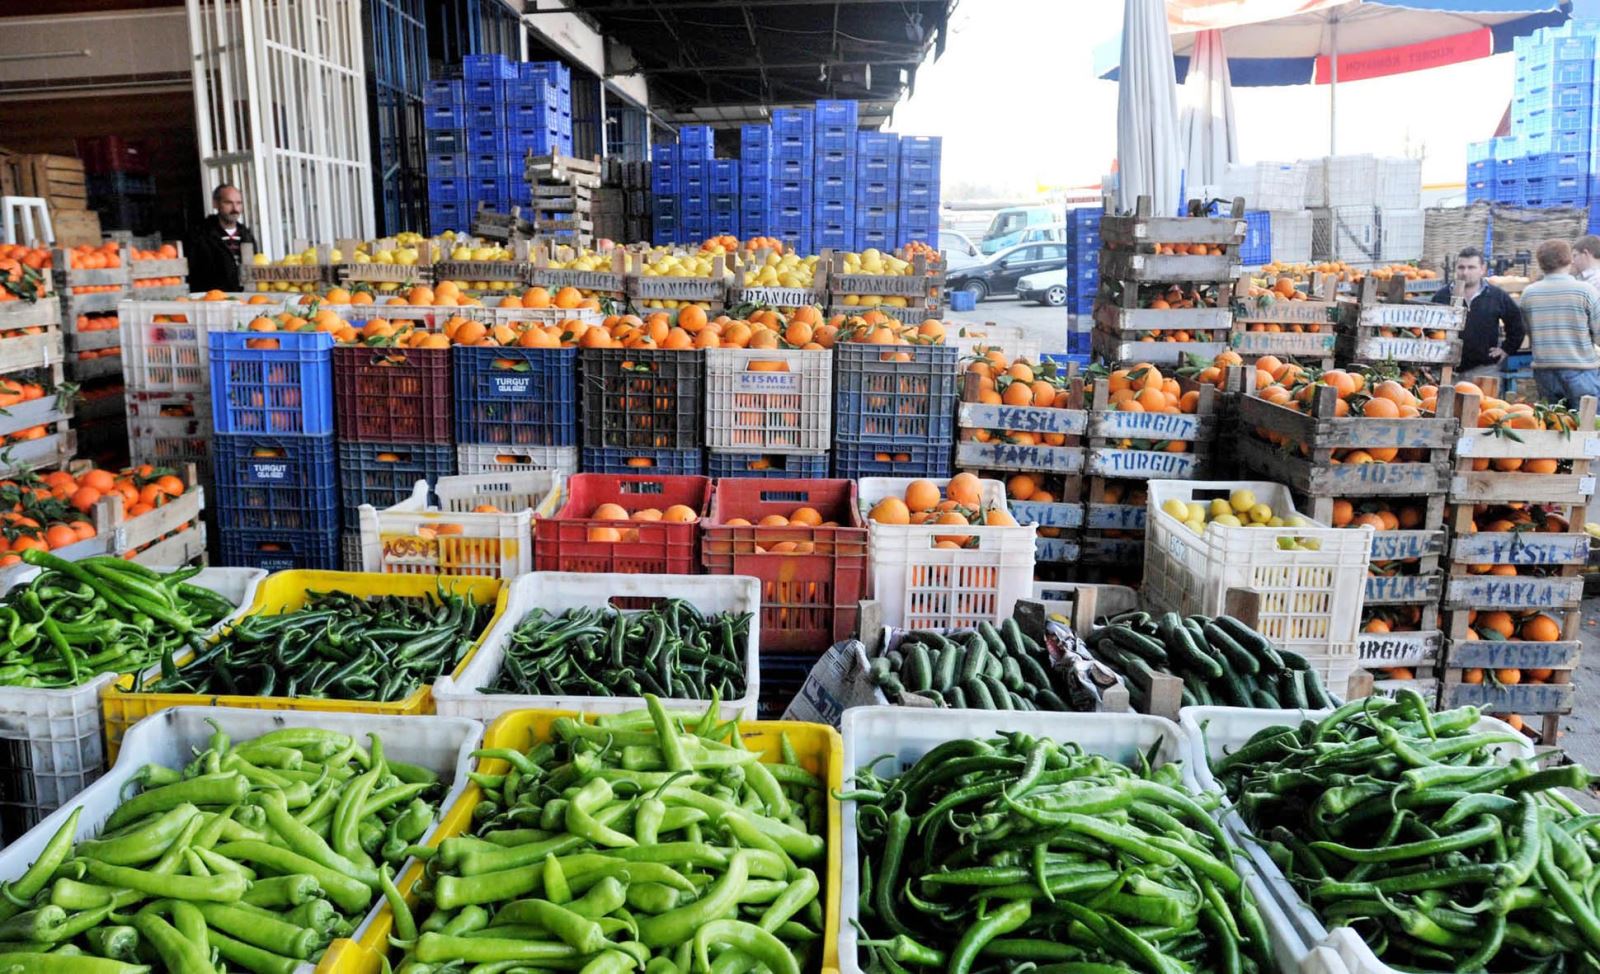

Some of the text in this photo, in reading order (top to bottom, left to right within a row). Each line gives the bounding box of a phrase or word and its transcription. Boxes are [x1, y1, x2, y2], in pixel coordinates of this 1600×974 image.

[494, 377, 531, 386] TURGUT
[741, 374, 796, 384] KISMET
[1115, 412, 1193, 437] TURGUT
[253, 464, 288, 472] TURGUT
[1111, 453, 1190, 475] TURGUT
[1365, 577, 1416, 599] AYLA
